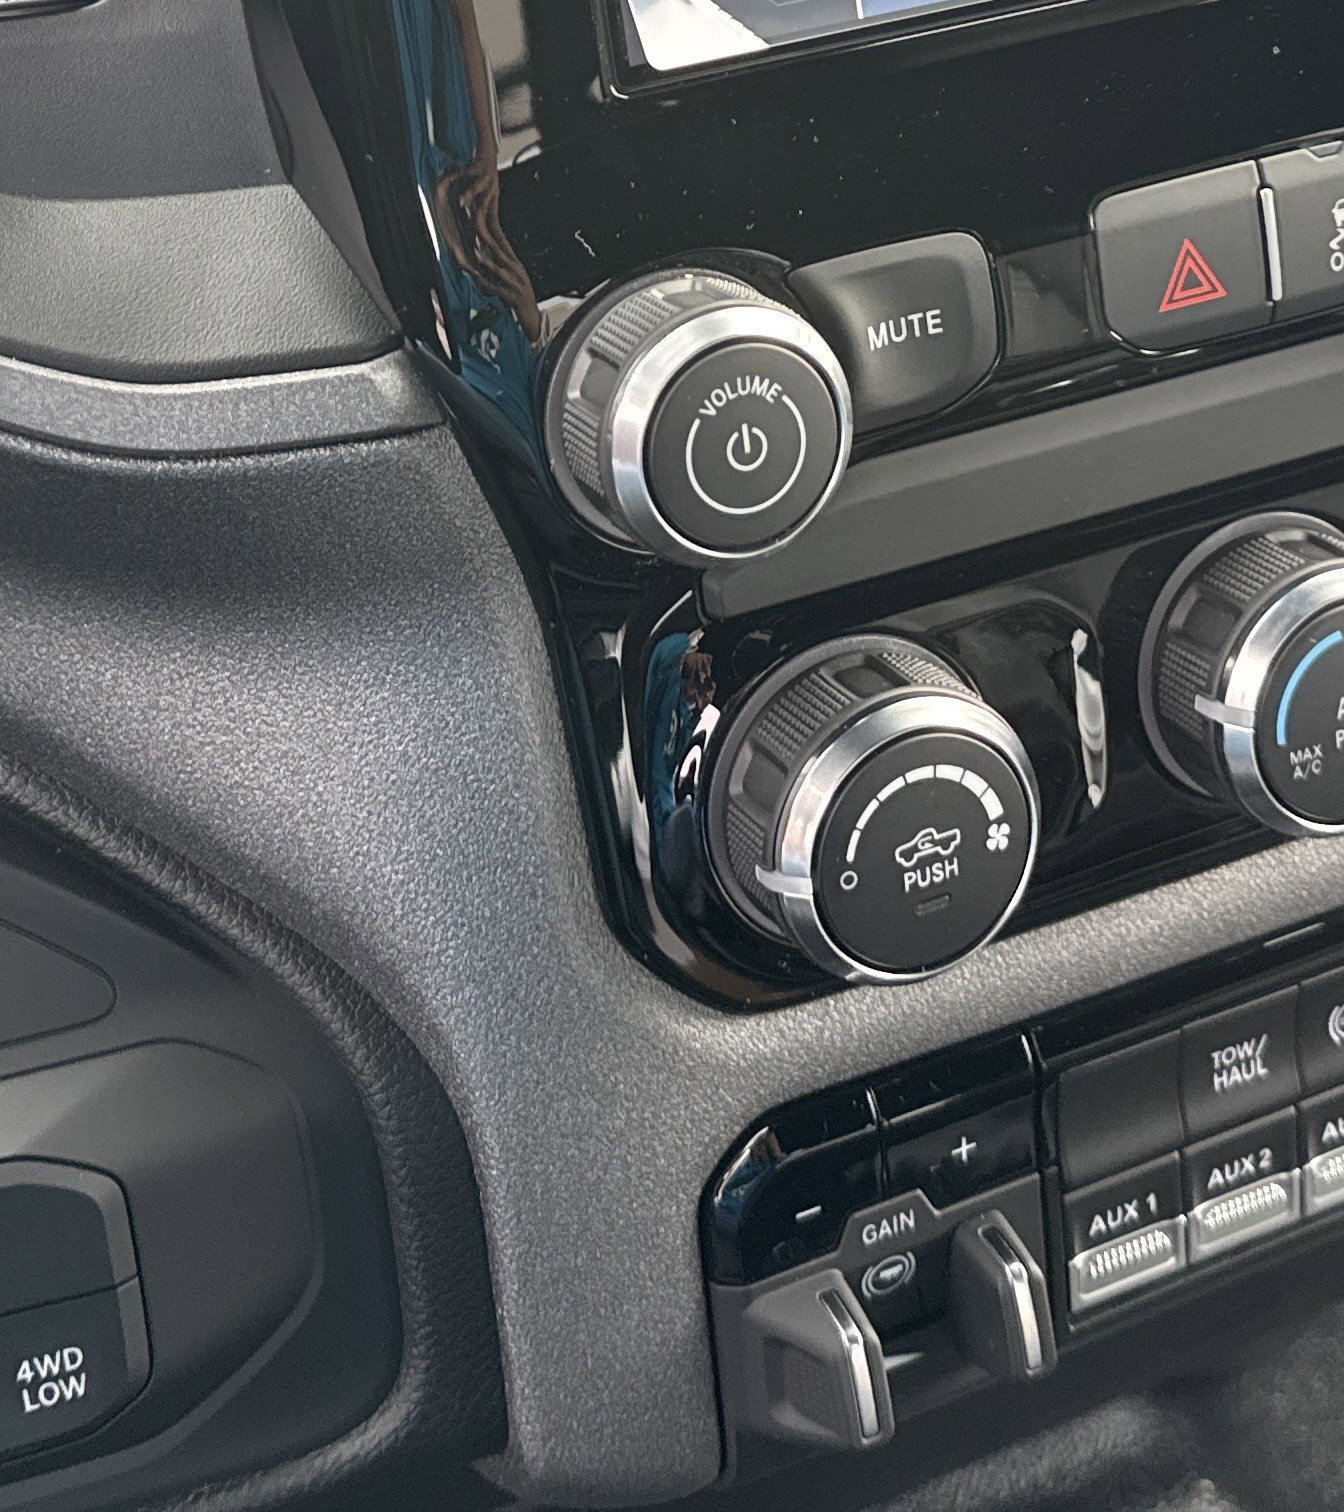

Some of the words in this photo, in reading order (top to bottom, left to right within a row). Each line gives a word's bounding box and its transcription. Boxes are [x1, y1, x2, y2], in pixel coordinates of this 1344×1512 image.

[868, 309, 944, 351] MUTE
[699, 375, 783, 417] VOLUME
[1289, 743, 1323, 767] MAX
[1293, 758, 1322, 781] A/C
[903, 857, 959, 892] PUSH
[1212, 1033, 1268, 1069] TOW/
[1214, 1058, 1268, 1092] HAUL
[1206, 1158, 1254, 1189] AUX
[1258, 1148, 1274, 1170] 2
[862, 1210, 915, 1245] GAIN
[1089, 1205, 1138, 1237] AUX
[1147, 1193, 1157, 1215] 1
[16, 1346, 84, 1386] 4WD
[22, 1373, 88, 1413] LOW
